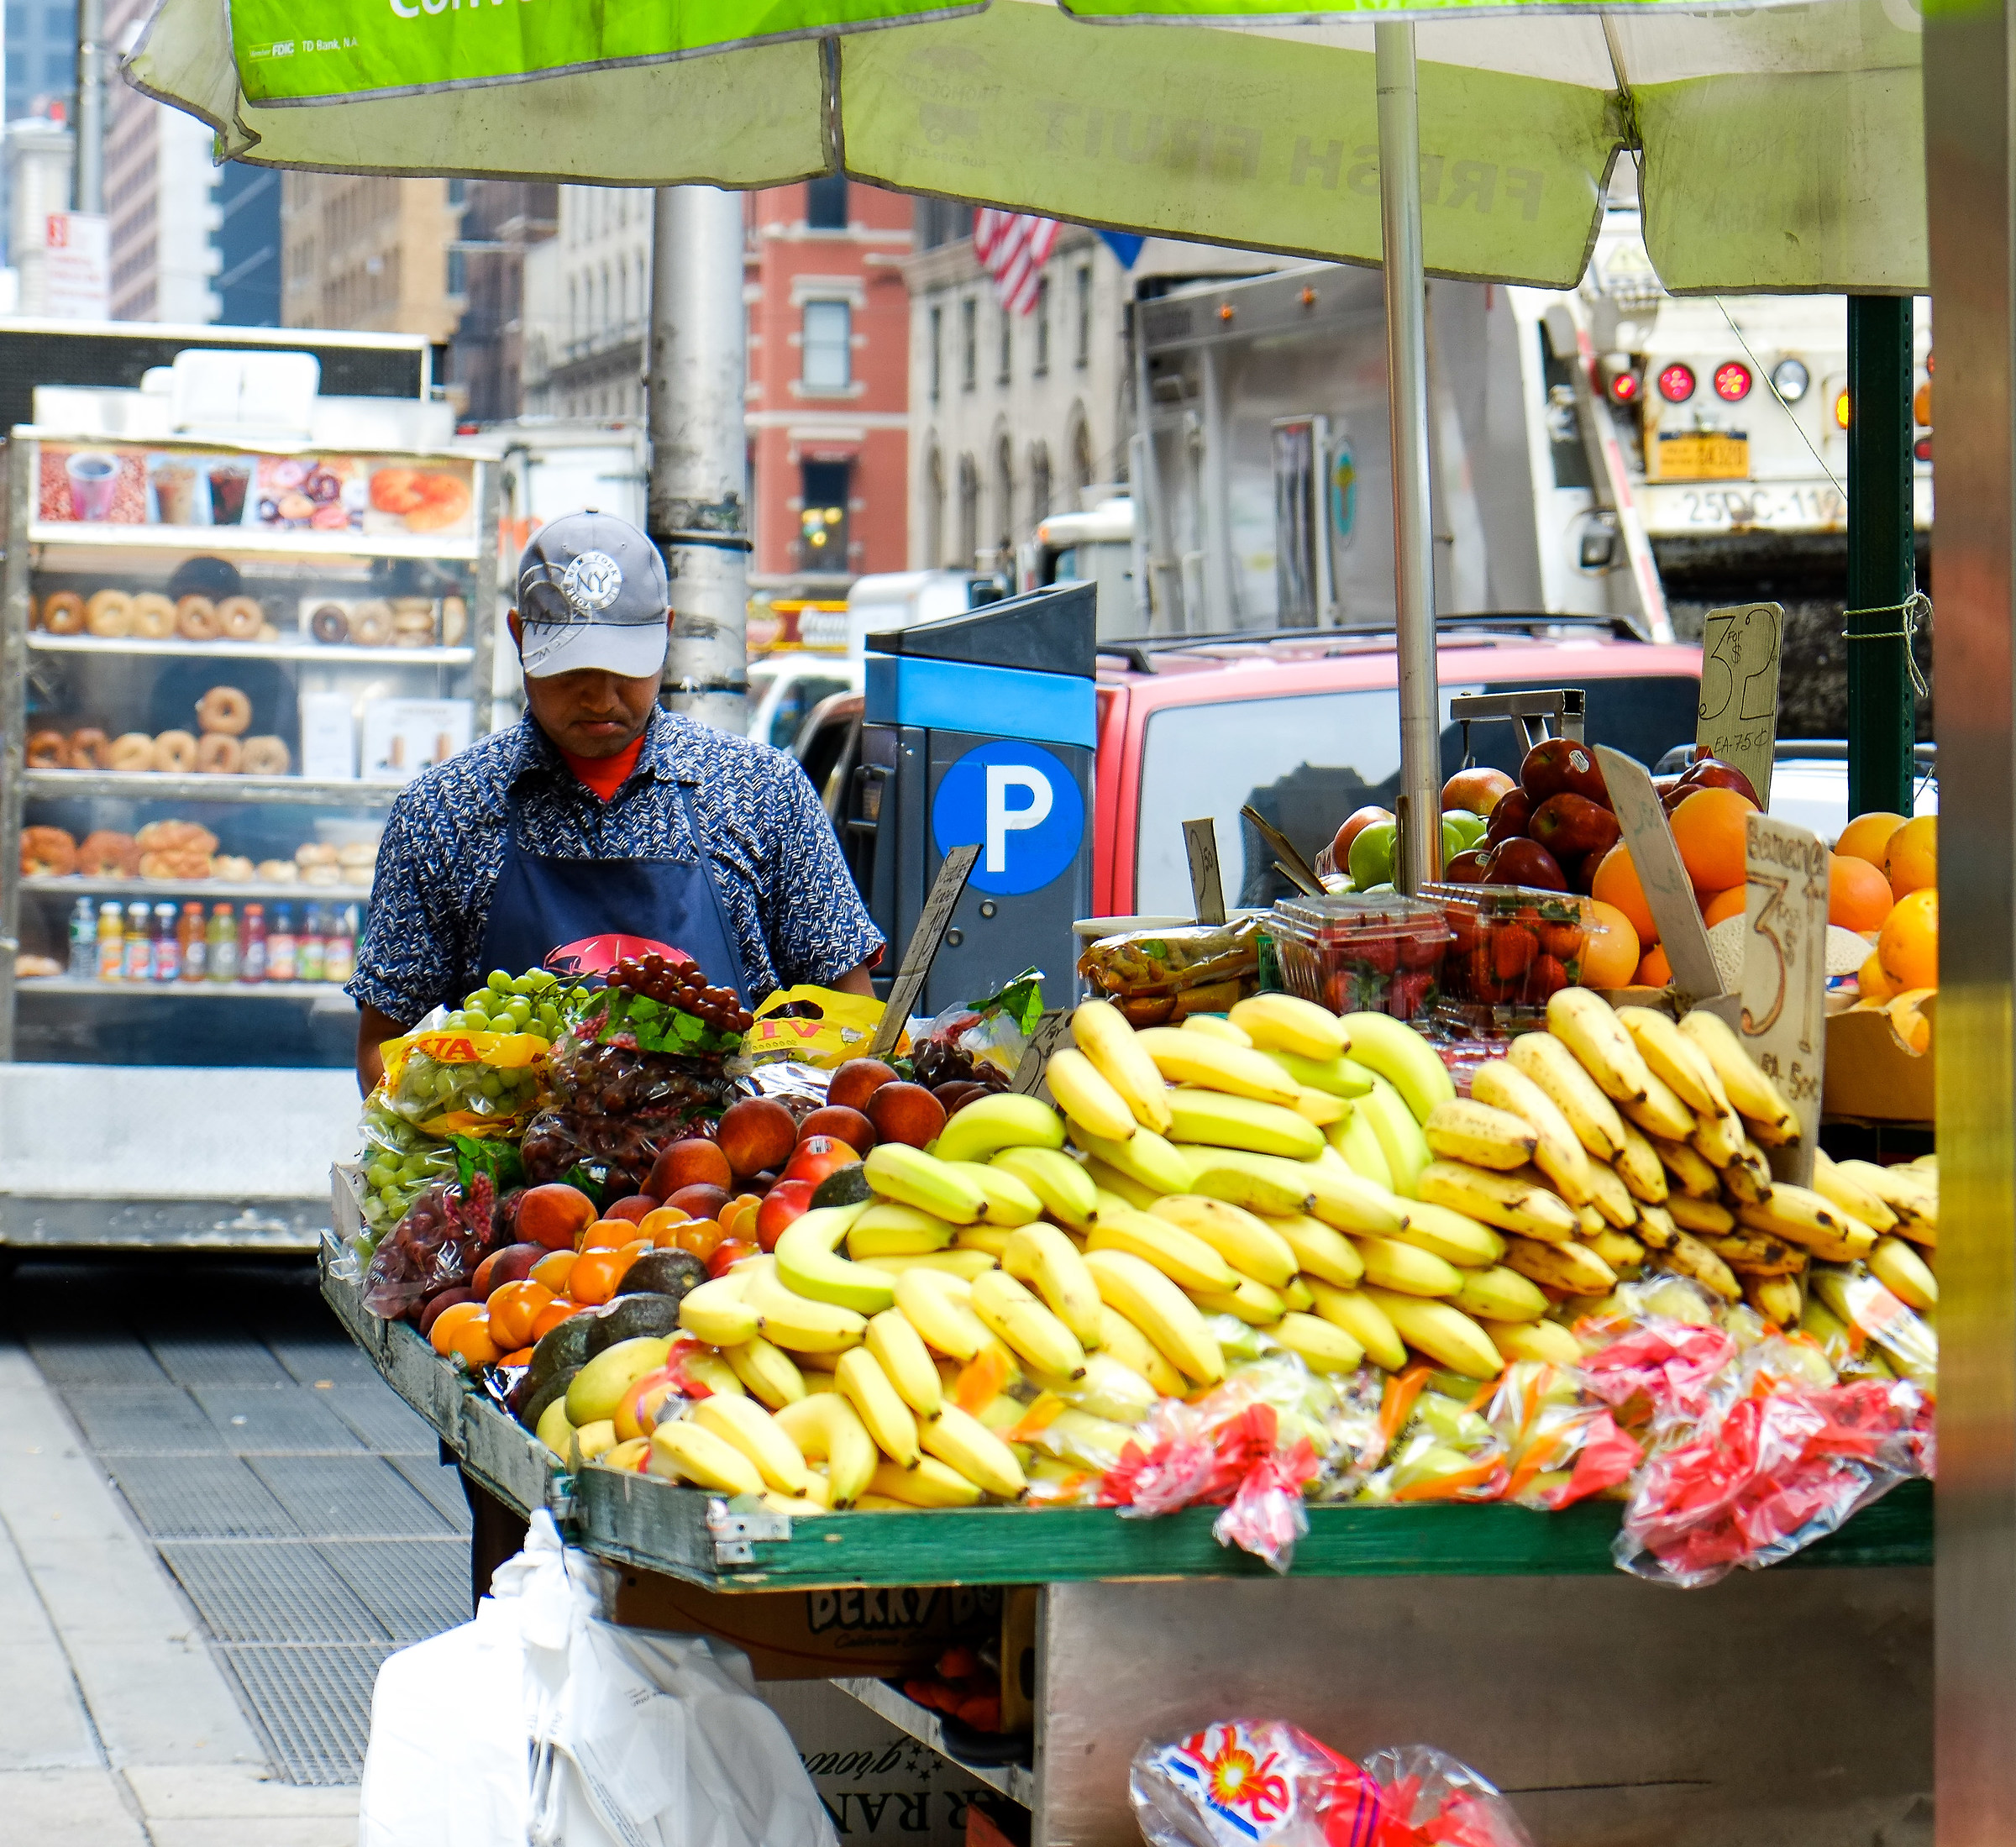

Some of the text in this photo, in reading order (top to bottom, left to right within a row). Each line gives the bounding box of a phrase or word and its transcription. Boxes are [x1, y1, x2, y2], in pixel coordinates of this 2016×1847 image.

[272, 42, 294, 57] FDIC
[302, 40, 314, 52] TD
[594, 553, 618, 577] YORK
[575, 570, 610, 594] NY
[1698, 615, 1736, 721] 3
[1740, 608, 1777, 721] 2
[985, 764, 1053, 873] P
[1740, 871, 1788, 1036] 3
